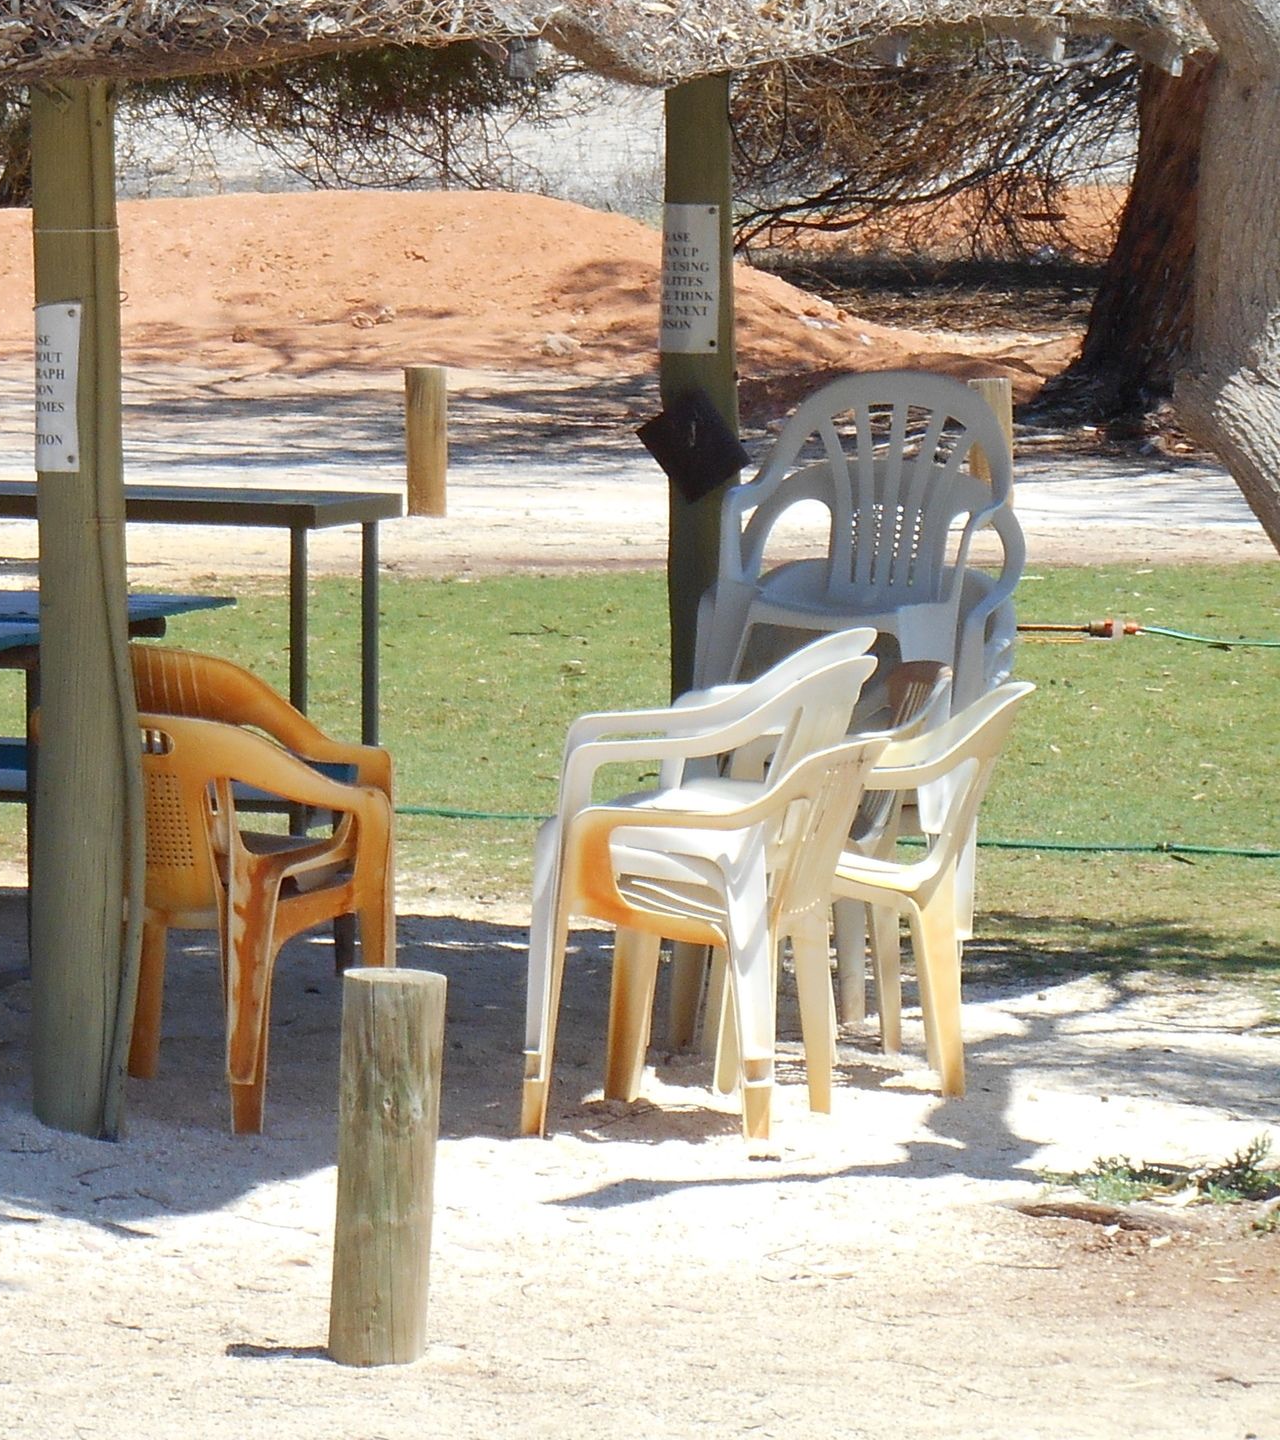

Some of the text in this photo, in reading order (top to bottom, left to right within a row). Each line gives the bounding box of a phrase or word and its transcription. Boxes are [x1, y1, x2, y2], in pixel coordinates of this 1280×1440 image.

[672, 261, 710, 272] USING
[673, 290, 713, 301] THINK
[675, 305, 708, 316] NEXT
